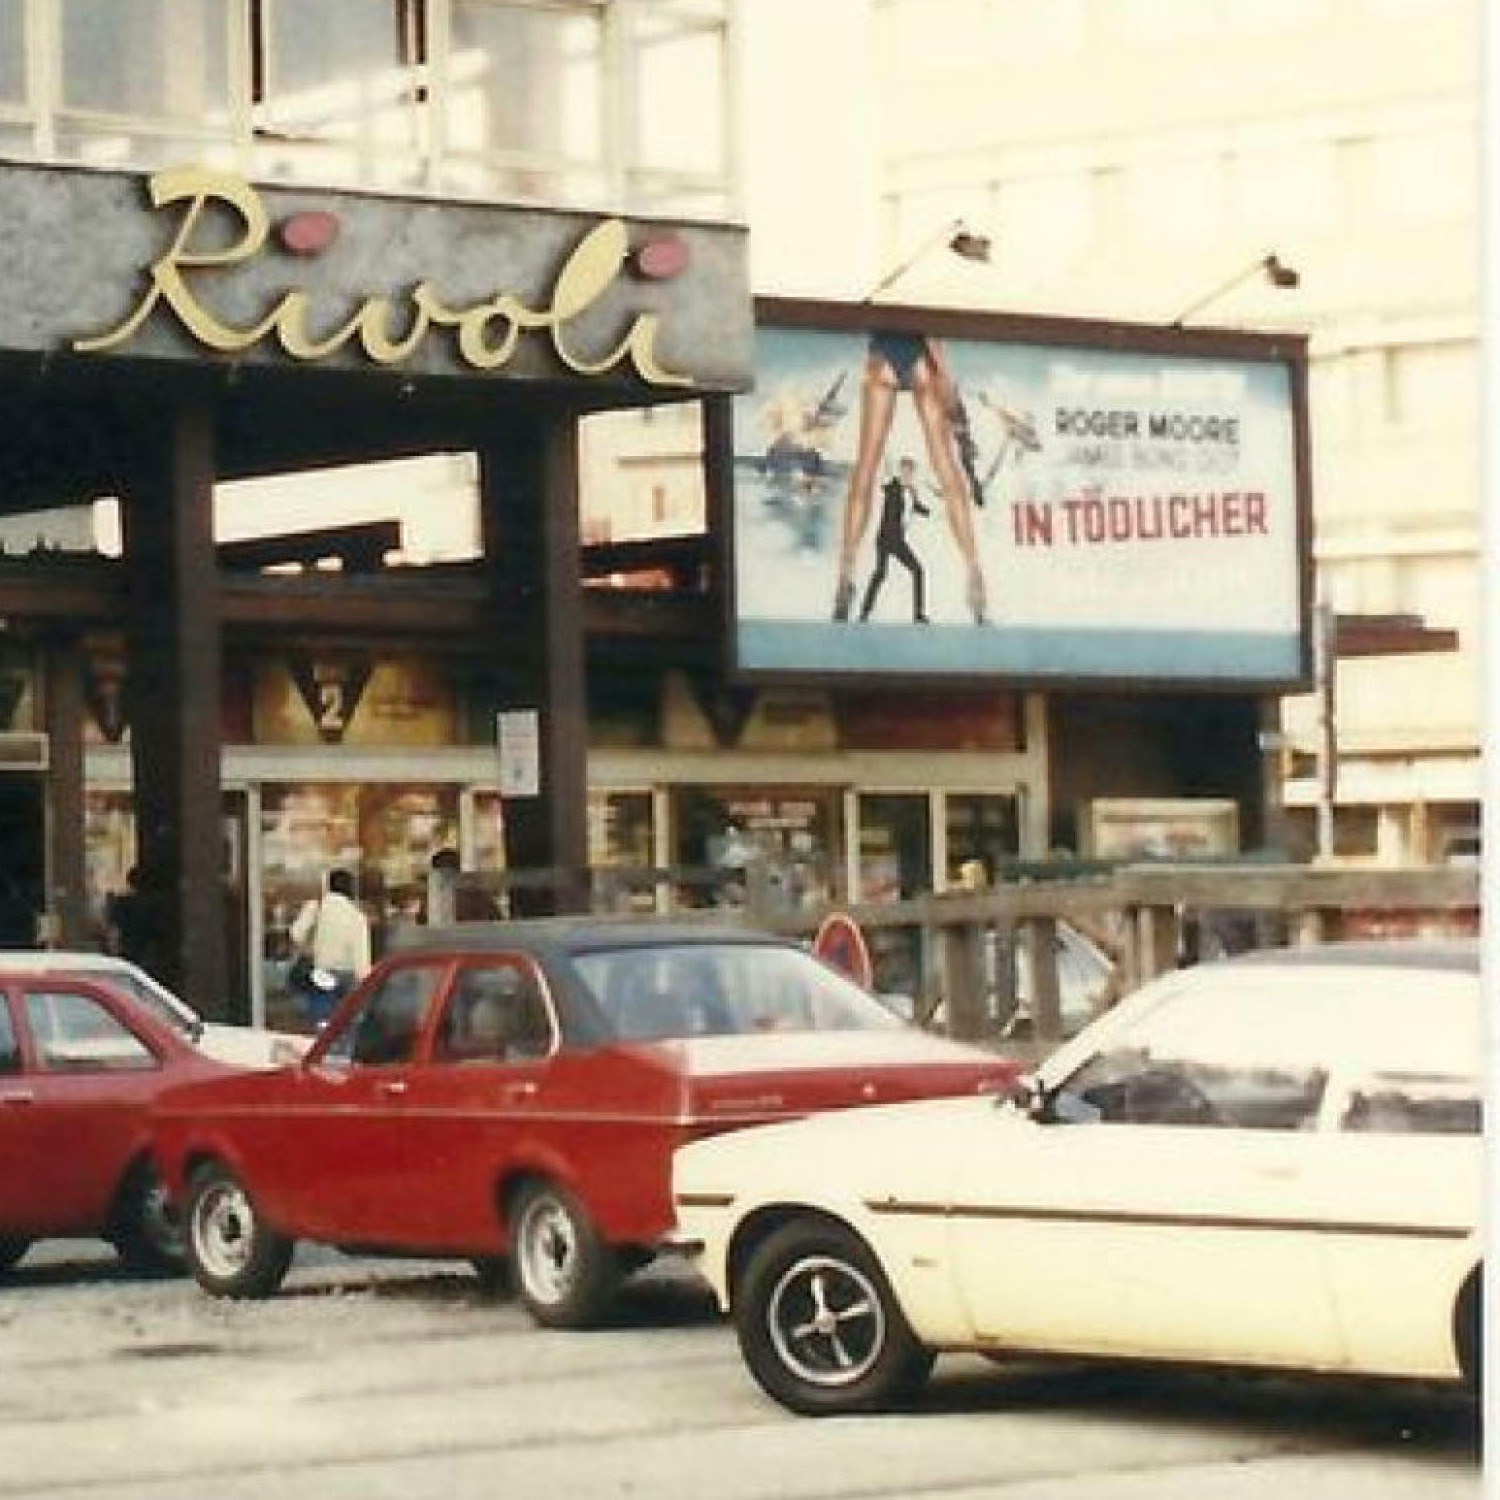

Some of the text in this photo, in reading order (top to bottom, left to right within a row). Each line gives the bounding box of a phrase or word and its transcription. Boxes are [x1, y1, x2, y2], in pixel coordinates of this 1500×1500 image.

[72, 168, 692, 388] Rivoli
[1055, 405, 1240, 445] ROGER MOORE
[1012, 500, 1053, 546] IN
